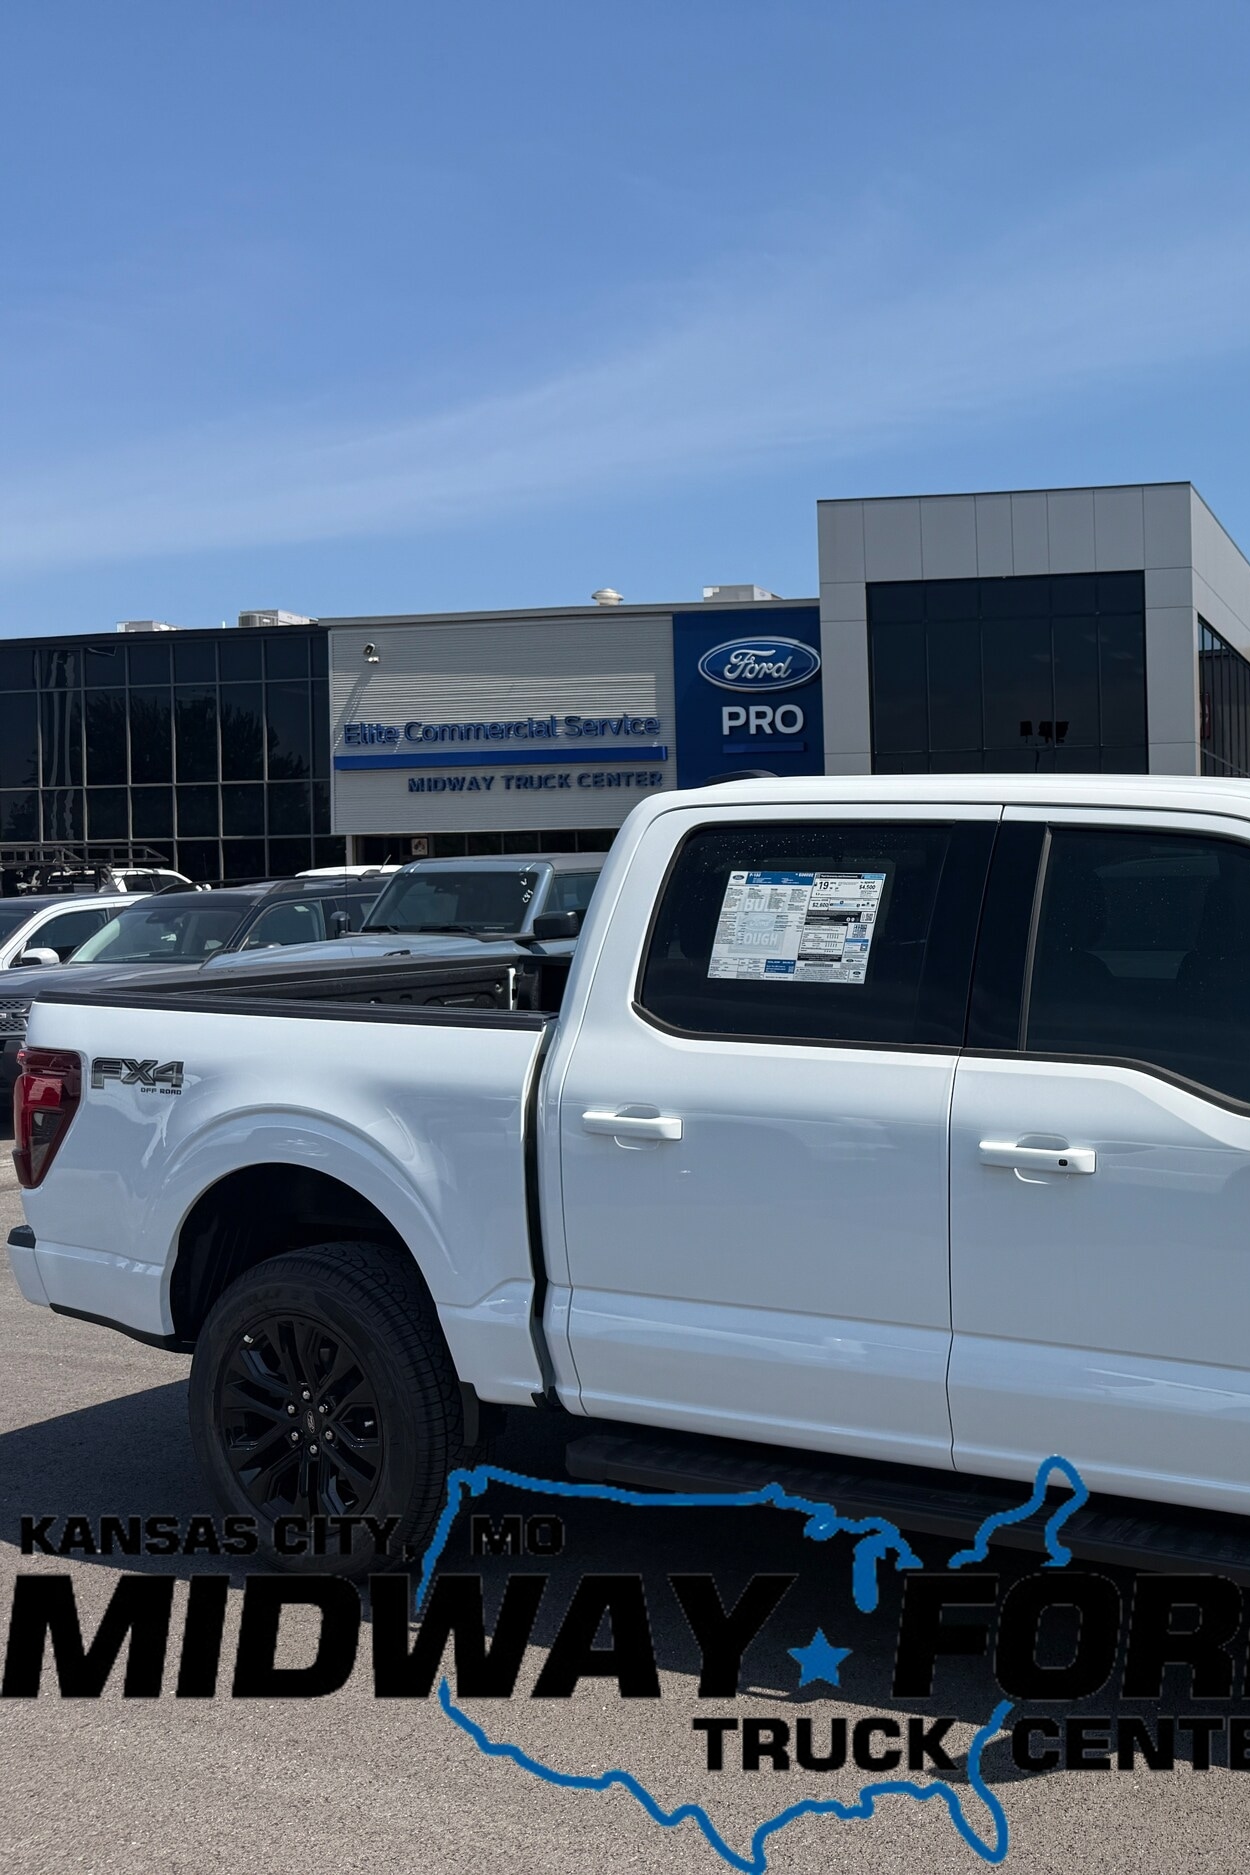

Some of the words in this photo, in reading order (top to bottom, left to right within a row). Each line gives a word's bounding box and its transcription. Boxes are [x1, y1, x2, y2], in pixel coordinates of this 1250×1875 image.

[723, 649, 793, 680] Ford
[344, 721, 398, 745] Elite
[404, 714, 558, 743] Commercial
[564, 712, 661, 738] Service
[722, 704, 804, 735] PRO
[408, 775, 494, 792] MIDWAY
[504, 773, 571, 791] TRUCK
[577, 771, 663, 788] CENTER
[819, 881, 829, 890] 19
[91, 1057, 184, 1089] FX4
